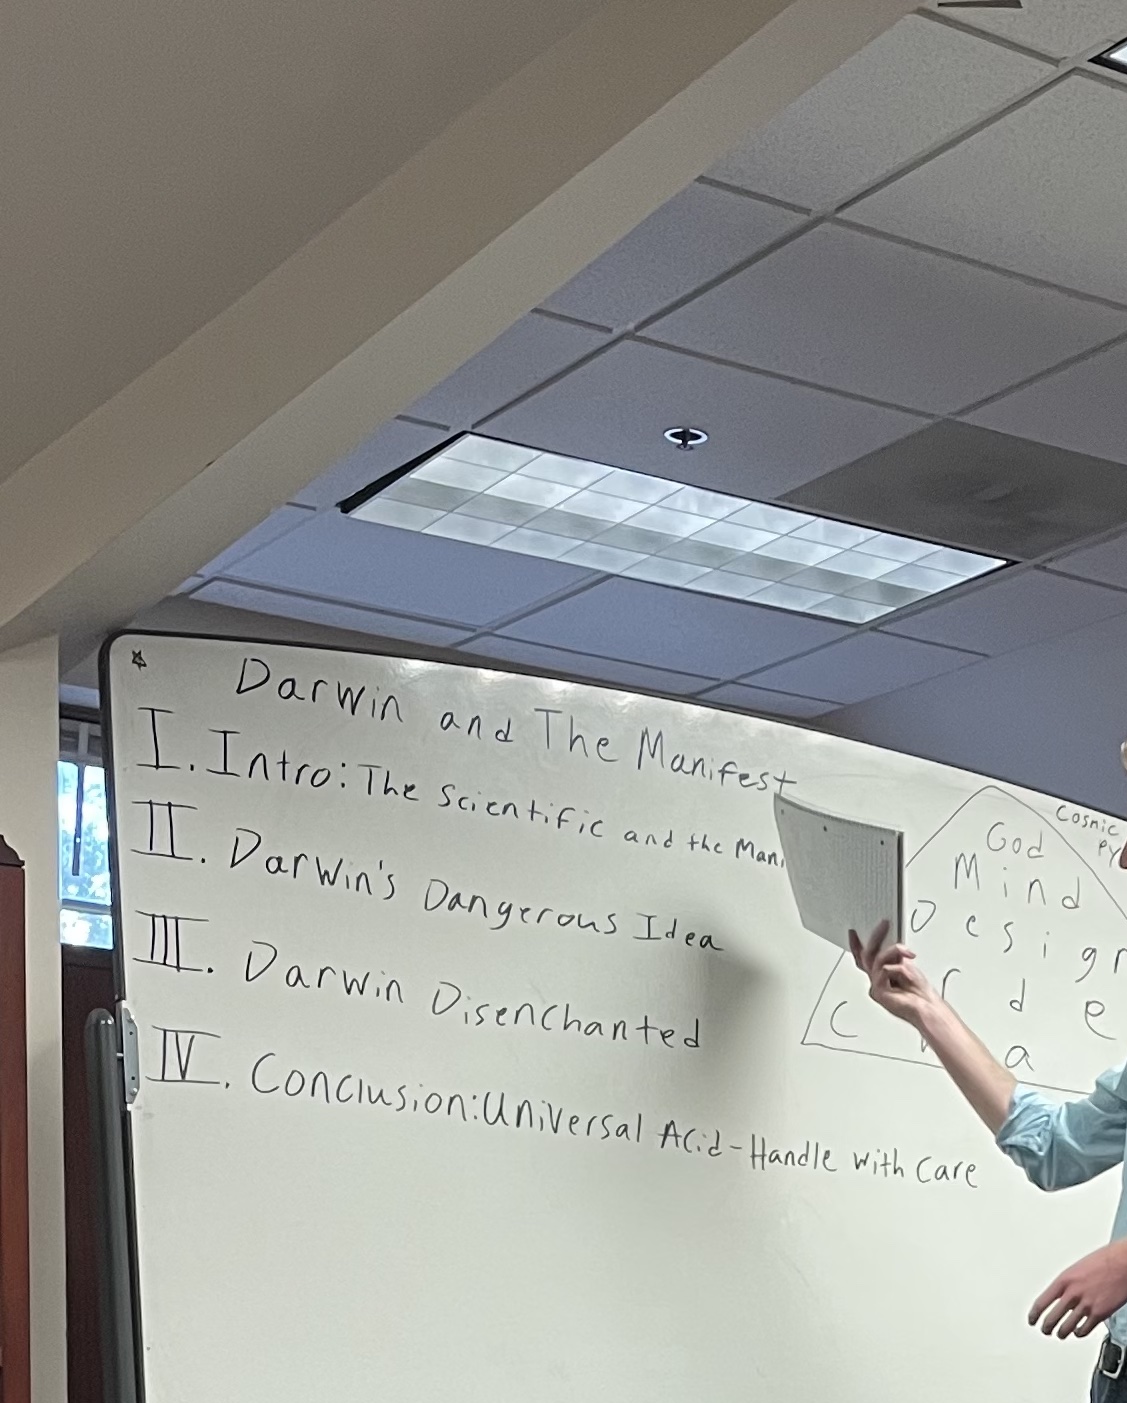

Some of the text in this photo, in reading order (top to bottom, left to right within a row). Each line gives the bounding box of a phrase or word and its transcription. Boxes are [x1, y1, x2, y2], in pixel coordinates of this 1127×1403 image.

[235, 657, 798, 796] Darwin and The Manifest
[135, 706, 195, 772] I.
[623, 829, 673, 849] and
[686, 832, 723, 855] the
[986, 821, 1045, 859] God
[1055, 804, 1118, 837] Cosmic
[229, 827, 396, 901] Darwin's
[423, 878, 618, 935] Dangerous
[632, 912, 725, 952] Idea
[954, 852, 1081, 910] Mind
[245, 939, 404, 1004] Darwin
